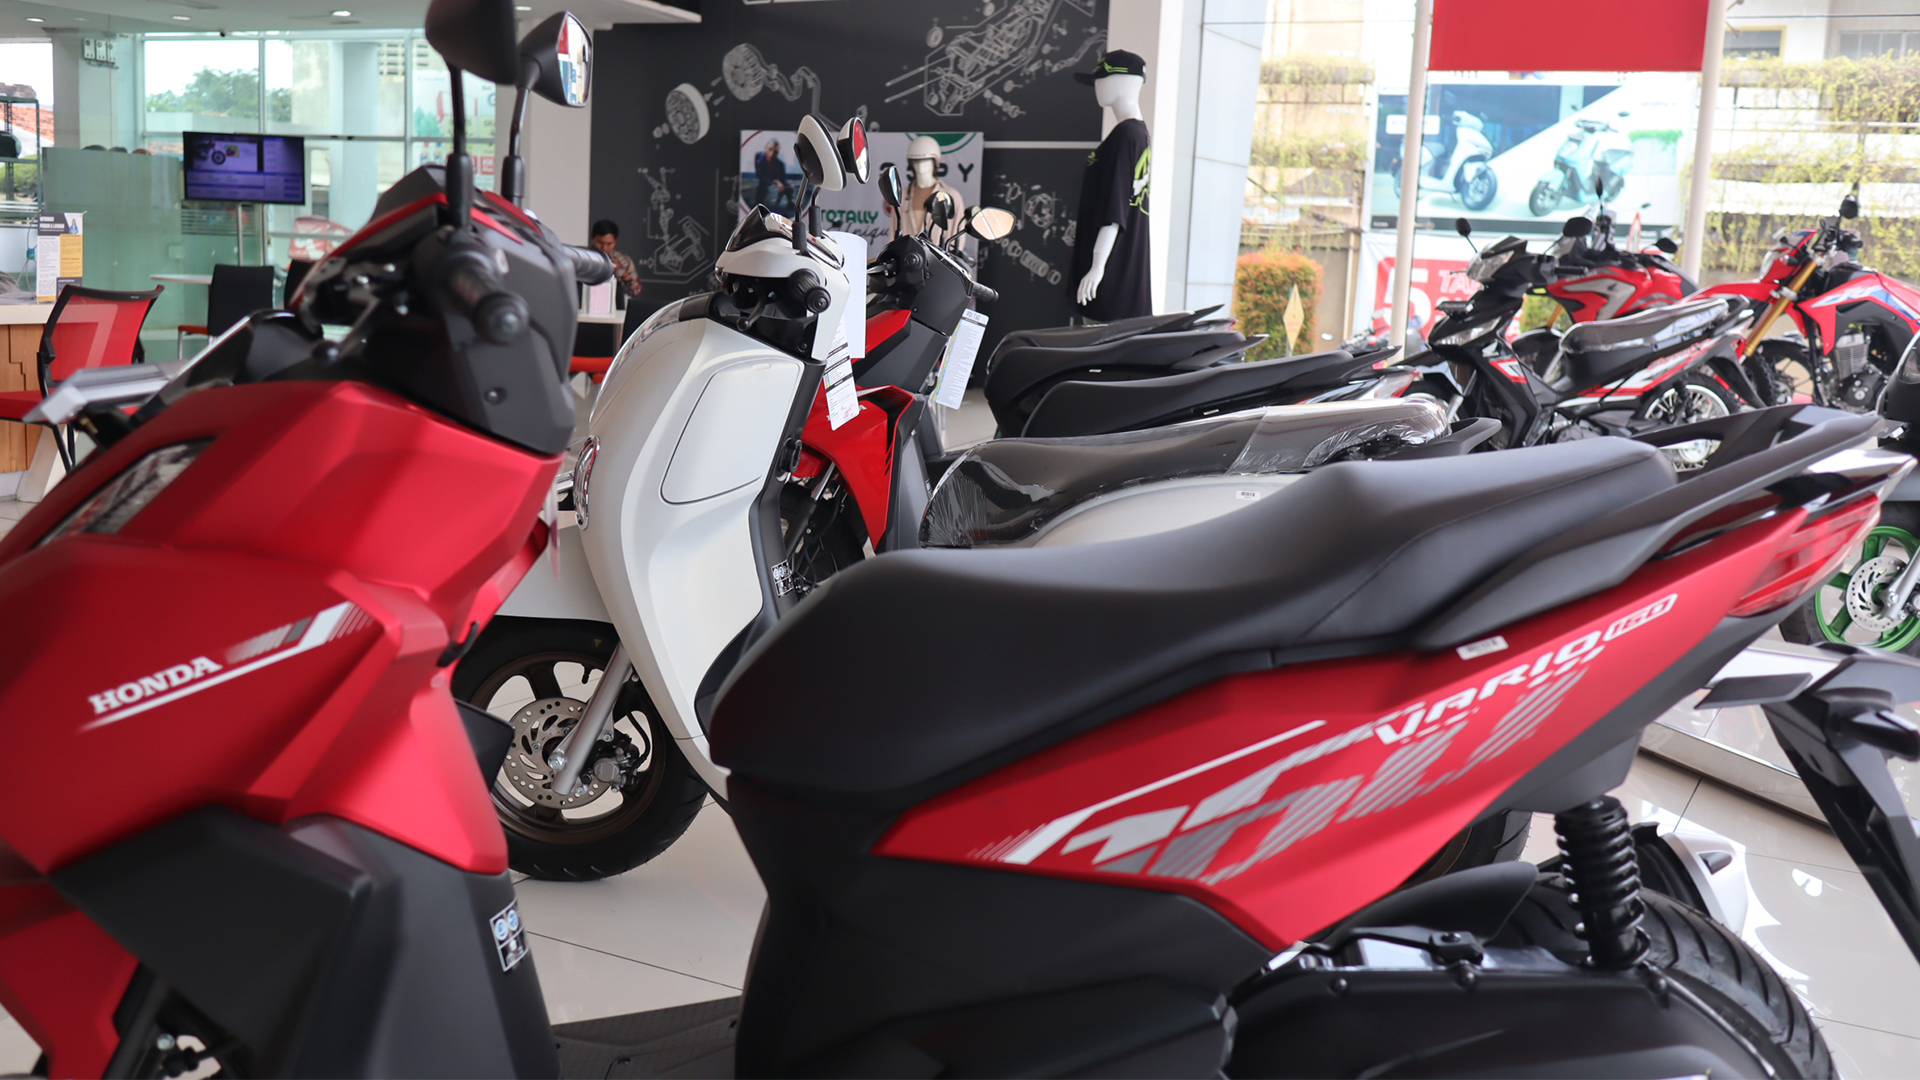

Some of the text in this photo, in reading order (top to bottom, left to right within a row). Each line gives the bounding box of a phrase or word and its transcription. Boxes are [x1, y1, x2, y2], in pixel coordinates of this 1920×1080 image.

[820, 210, 878, 224] TOTALLY
[87, 656, 223, 714] HONDA
[1375, 595, 1675, 744] VARIO 160
